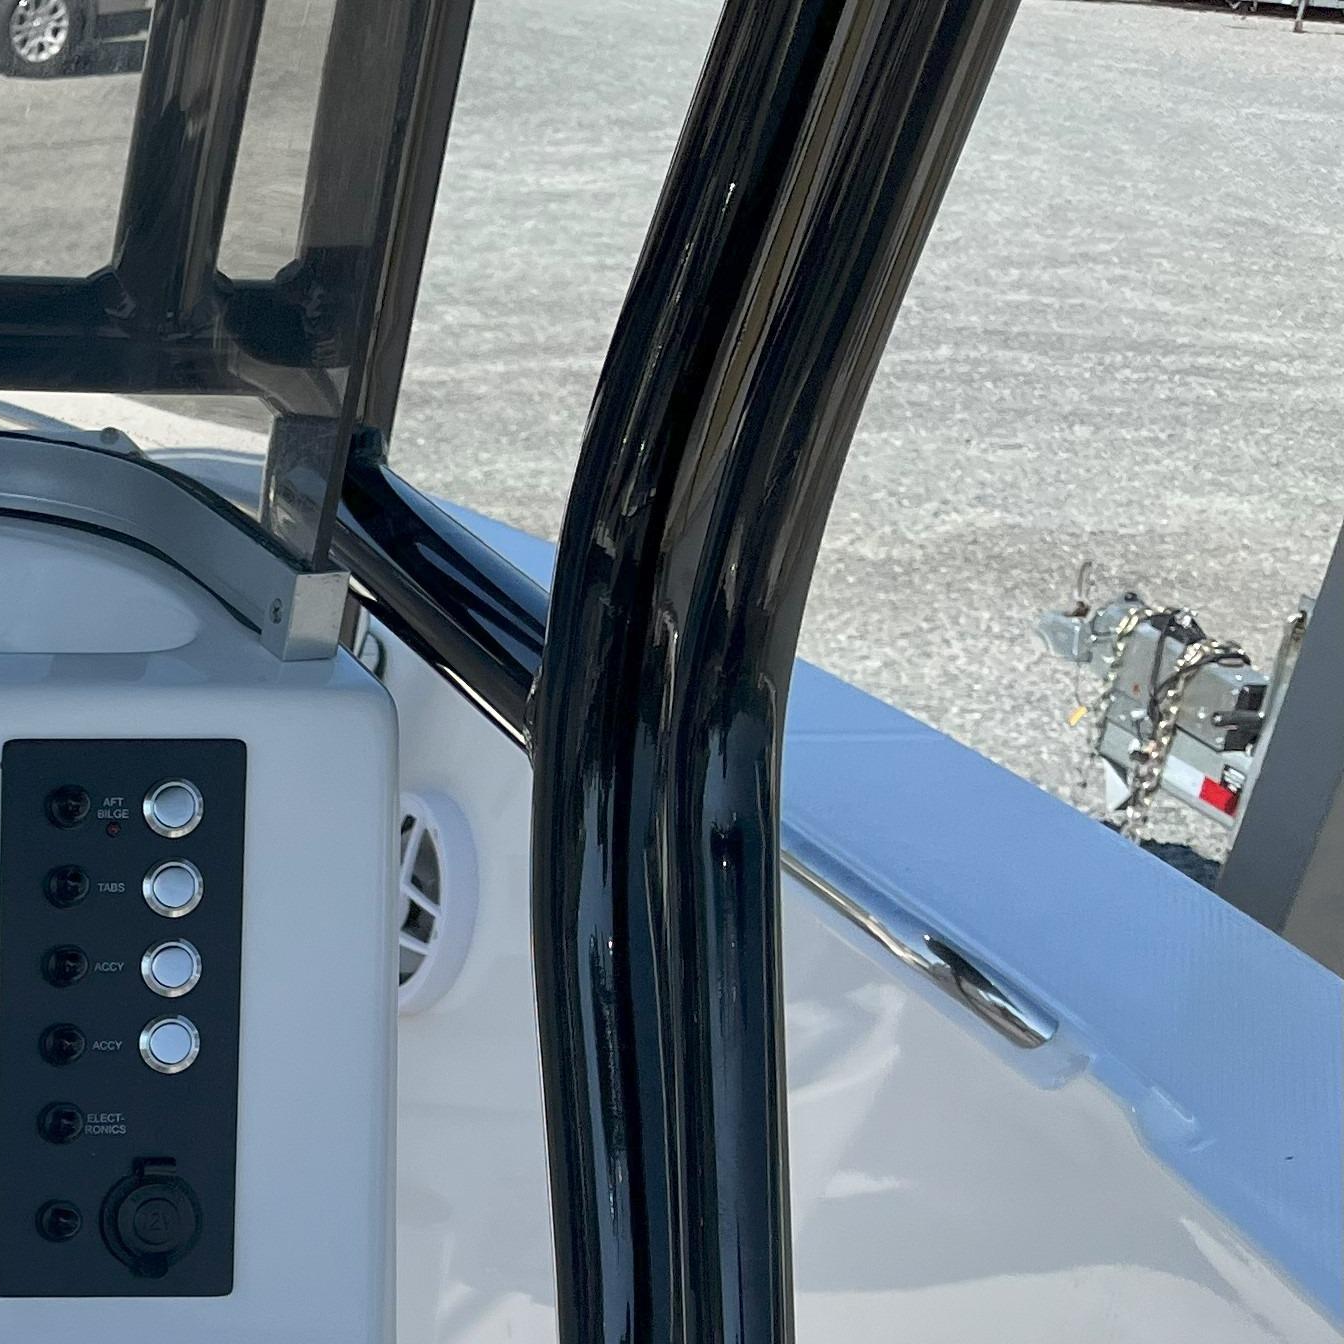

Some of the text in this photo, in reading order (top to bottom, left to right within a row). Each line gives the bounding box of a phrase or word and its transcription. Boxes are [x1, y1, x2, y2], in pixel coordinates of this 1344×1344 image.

[102, 798, 124, 807] AFT
[97, 809, 129, 819] BILGE
[98, 883, 126, 893] TABS
[94, 962, 125, 972] ACCY
[92, 1040, 123, 1051] ACCY
[87, 1114, 125, 1124] ELECT-
[84, 1124, 127, 1134] RONICS
